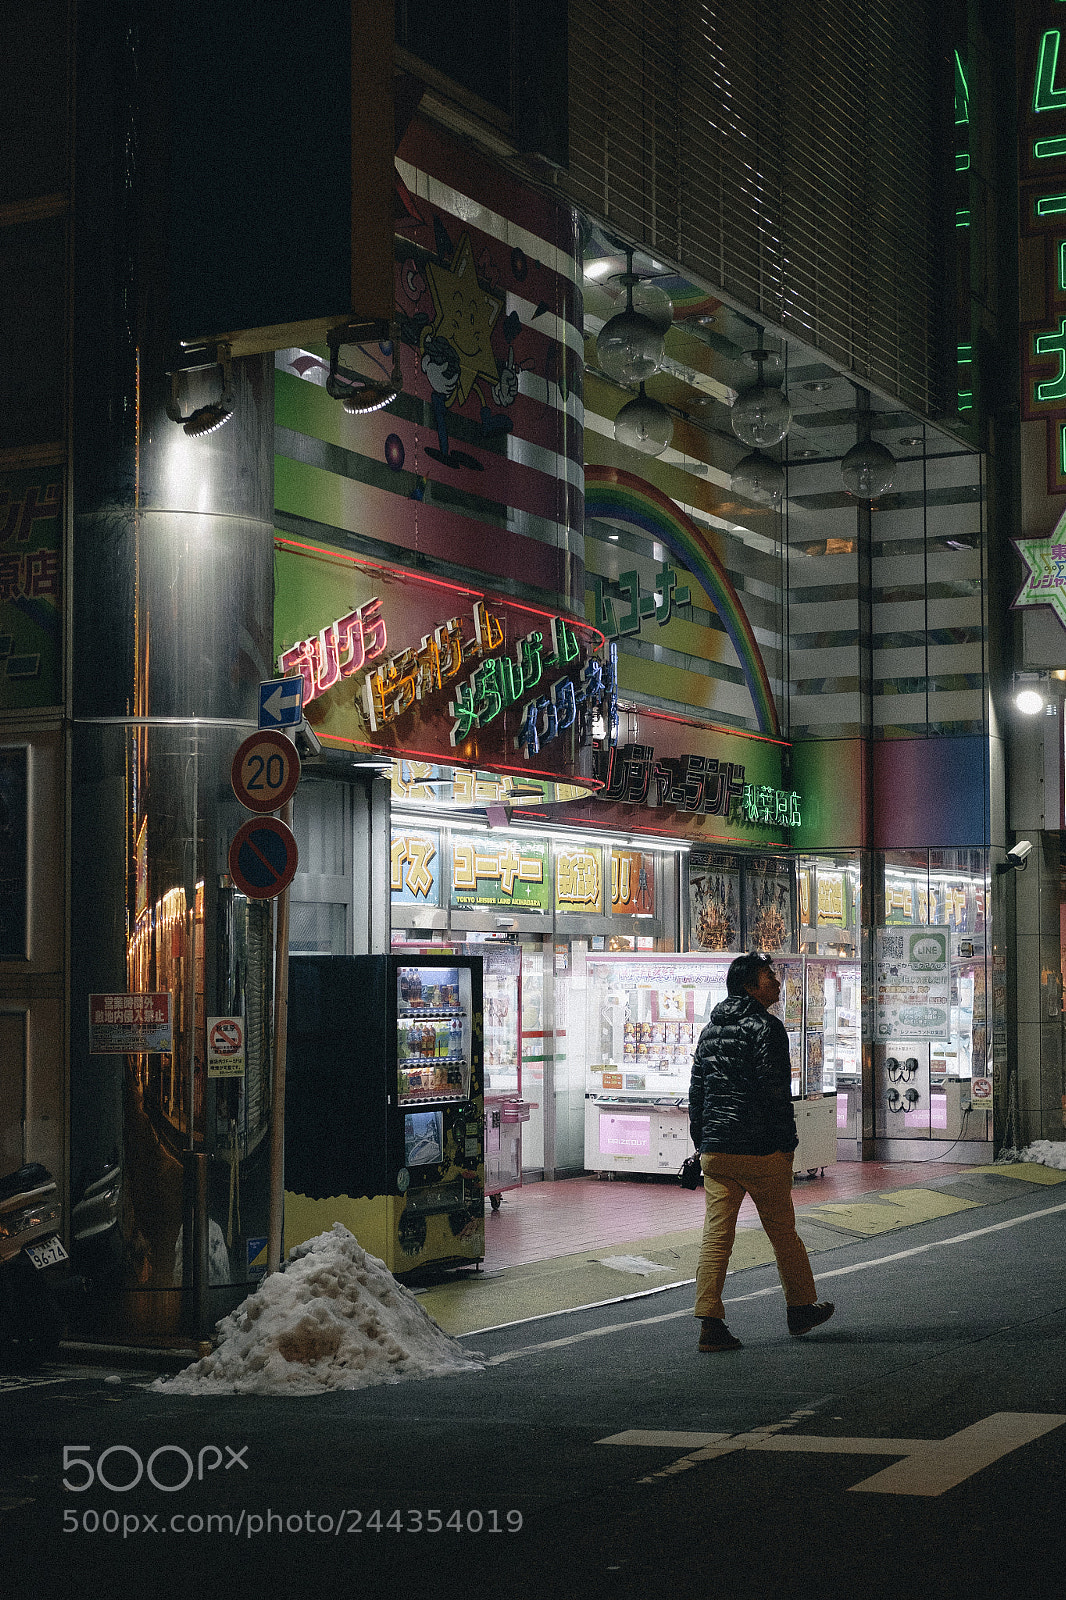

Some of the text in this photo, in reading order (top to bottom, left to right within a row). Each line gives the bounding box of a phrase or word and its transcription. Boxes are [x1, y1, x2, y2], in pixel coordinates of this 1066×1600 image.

[1029, 574, 1066, 590] レジャ
[277, 596, 388, 709] プリクラ
[364, 600, 504, 732] ビデオゲーム
[448, 616, 580, 748] メダルゲーム
[246, 753, 285, 791] 20
[743, 784, 802, 828] 秋葉原店
[456, 896, 476, 905] TOKYO
[476, 897, 497, 905] LEISURE
[497, 898, 512, 906] LAND
[917, 946, 938, 955] LINE
[104, 996, 154, 1010] 営業時間外
[94, 1010, 165, 1024] 敷地内侵入禁止
